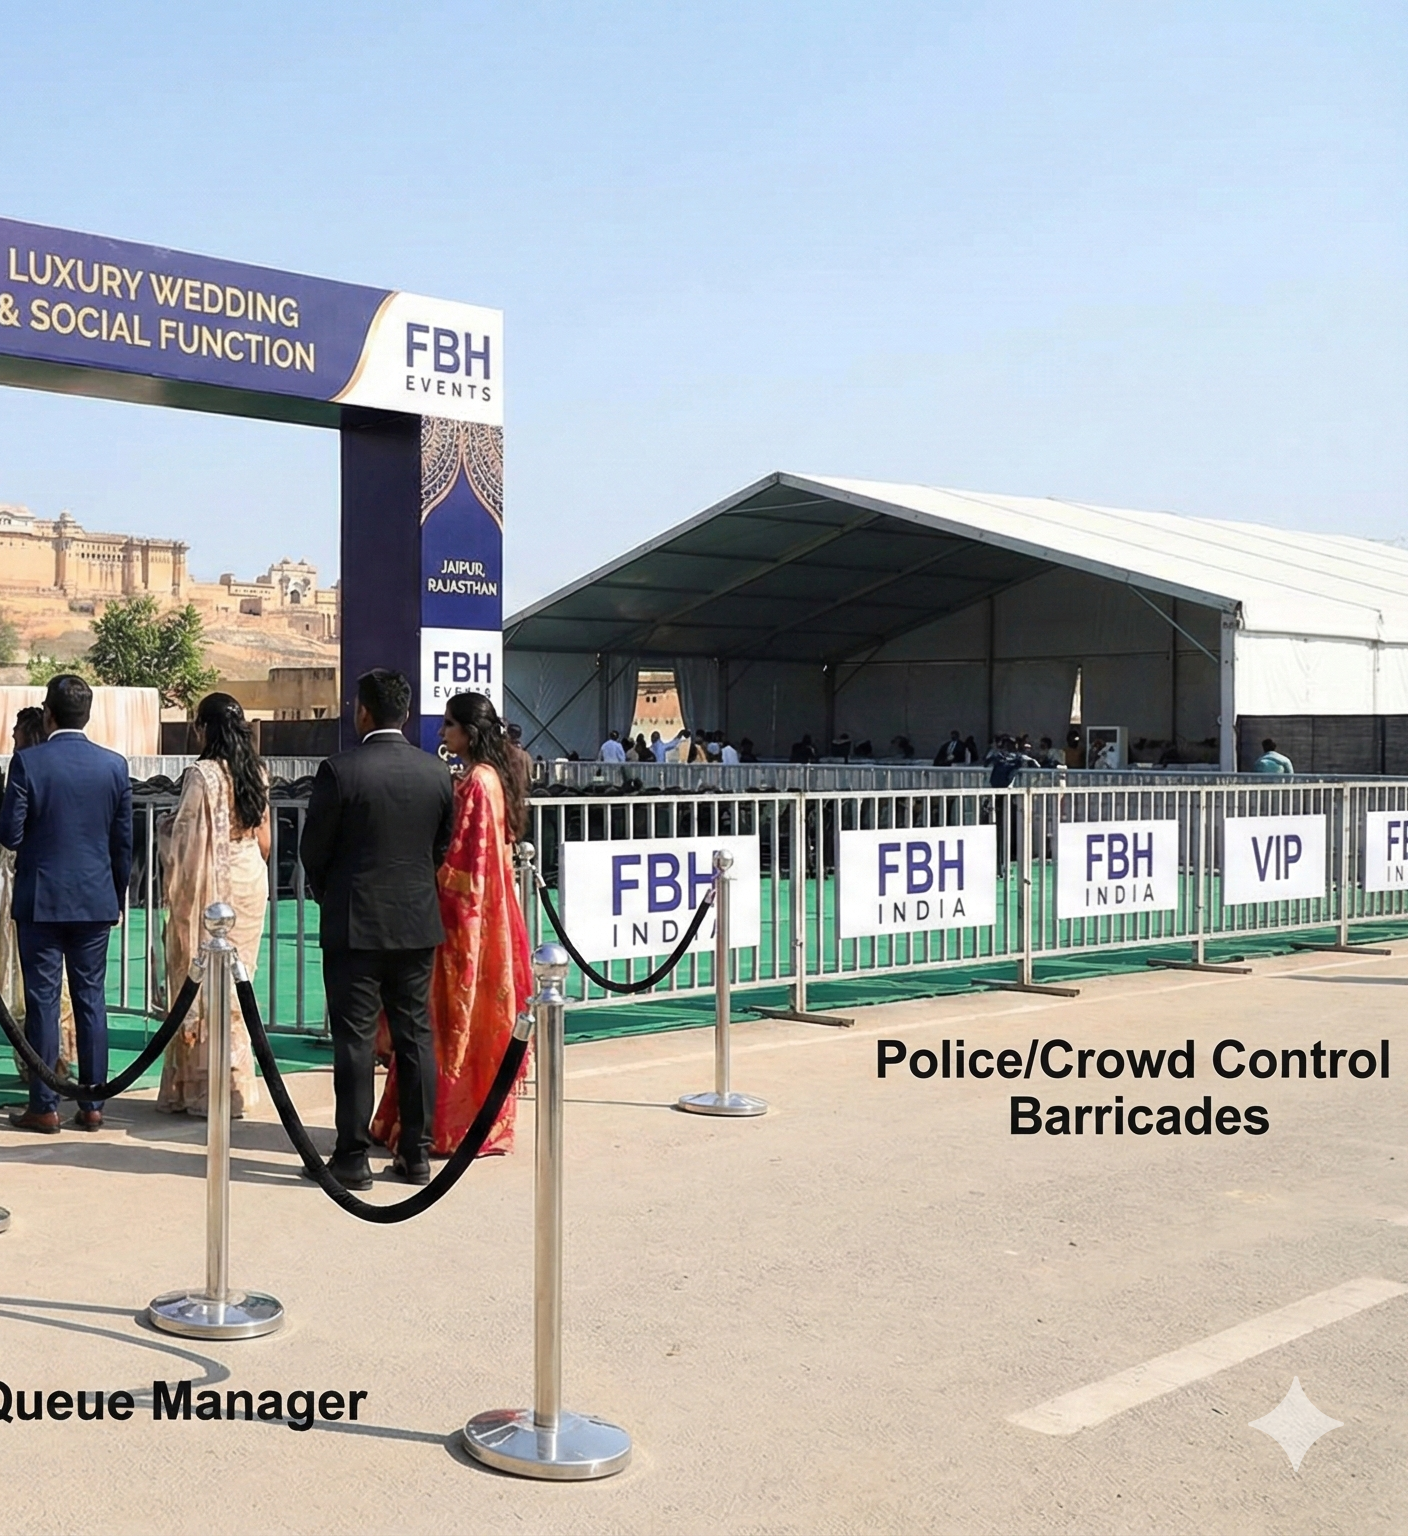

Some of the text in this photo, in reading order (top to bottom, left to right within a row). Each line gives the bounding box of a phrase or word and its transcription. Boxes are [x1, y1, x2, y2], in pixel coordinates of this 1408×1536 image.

[9, 247, 300, 328] LUXURY WEDDING
[30, 299, 151, 348] SOCIAL
[159, 318, 315, 374] FUNCTION
[406, 322, 490, 380] FBH
[406, 375, 491, 402] EVENTS
[428, 579, 497, 596] RAJASTHAN
[441, 560, 485, 578] JAIPUR,
[434, 651, 491, 684] FBH
[878, 839, 965, 897] FBH
[1086, 832, 1154, 882] FBH
[1251, 834, 1303, 882] VIP
[612, 850, 719, 917] FBH
[1086, 884, 1155, 907] INDIA
[879, 897, 966, 925] INDIA
